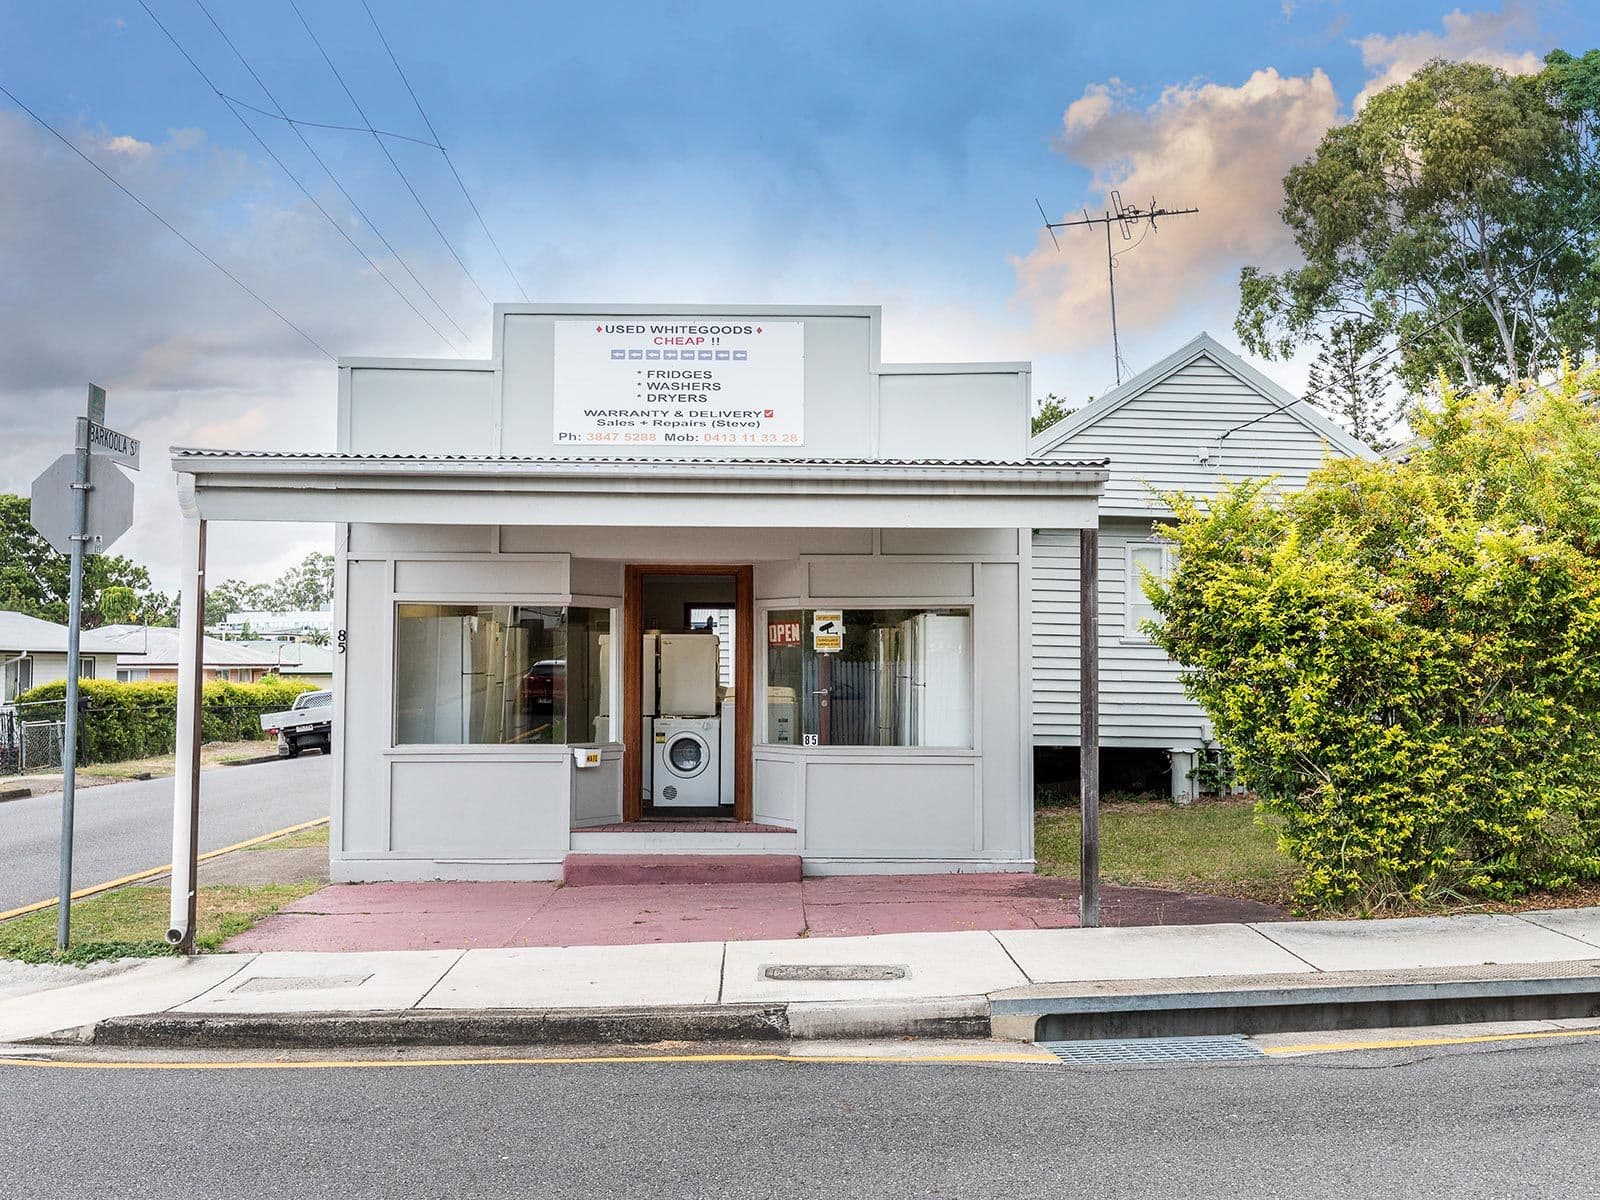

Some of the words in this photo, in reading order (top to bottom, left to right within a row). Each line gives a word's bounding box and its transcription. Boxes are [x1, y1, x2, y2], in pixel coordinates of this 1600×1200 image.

[605, 325, 646, 334] USED
[650, 325, 753, 334] WHITEGOODS
[653, 337, 705, 345] CHEAP
[647, 370, 712, 379] FRIDGES
[646, 382, 722, 391] WASHERS
[647, 394, 708, 403] DRYERS
[653, 420, 707, 428] Repairs
[712, 420, 761, 428] (Steve)
[90, 425, 128, 455] BARKOOLA
[559, 432, 581, 440] Ph:
[587, 433, 619, 441] 3847
[624, 433, 656, 441] 5288
[665, 433, 699, 442] Mob:
[704, 433, 737, 442] 0413
[742, 434, 756, 442] 11
[761, 434, 777, 442] 33
[782, 434, 798, 442] 28
[769, 624, 800, 642] OPEN
[338, 630, 346, 654] 85
[804, 735, 817, 745] 85
